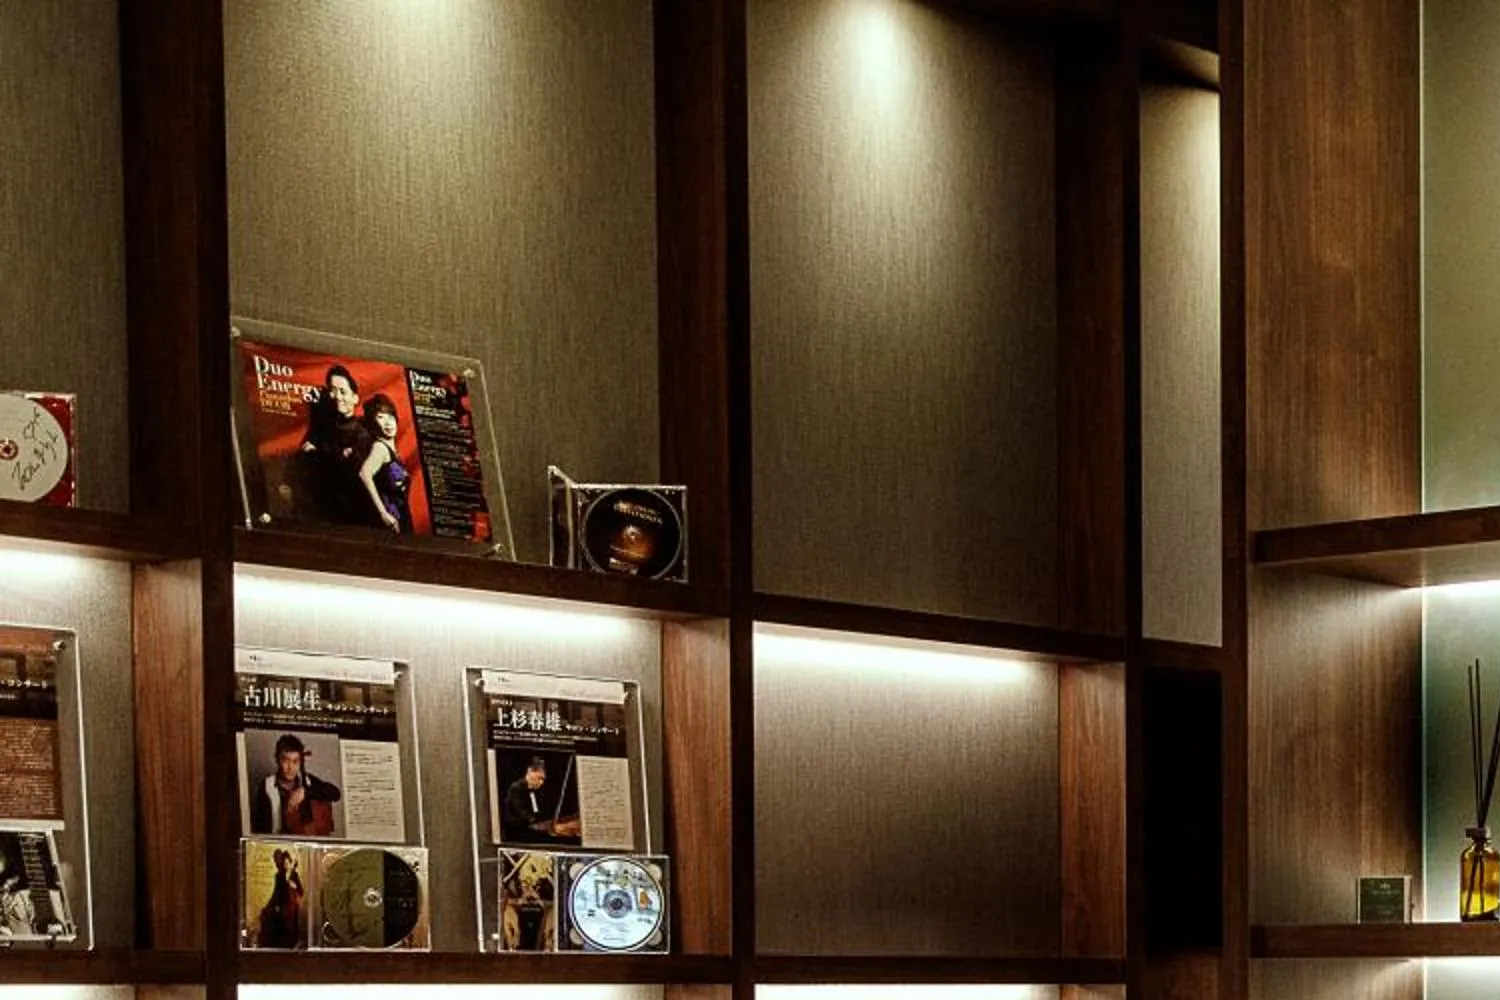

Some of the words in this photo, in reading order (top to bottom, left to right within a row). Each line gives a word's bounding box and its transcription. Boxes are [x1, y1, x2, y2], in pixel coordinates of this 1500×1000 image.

[254, 355, 293, 377] Duo
[256, 373, 323, 404] Energy
[493, 706, 562, 732] 上杉春雄
